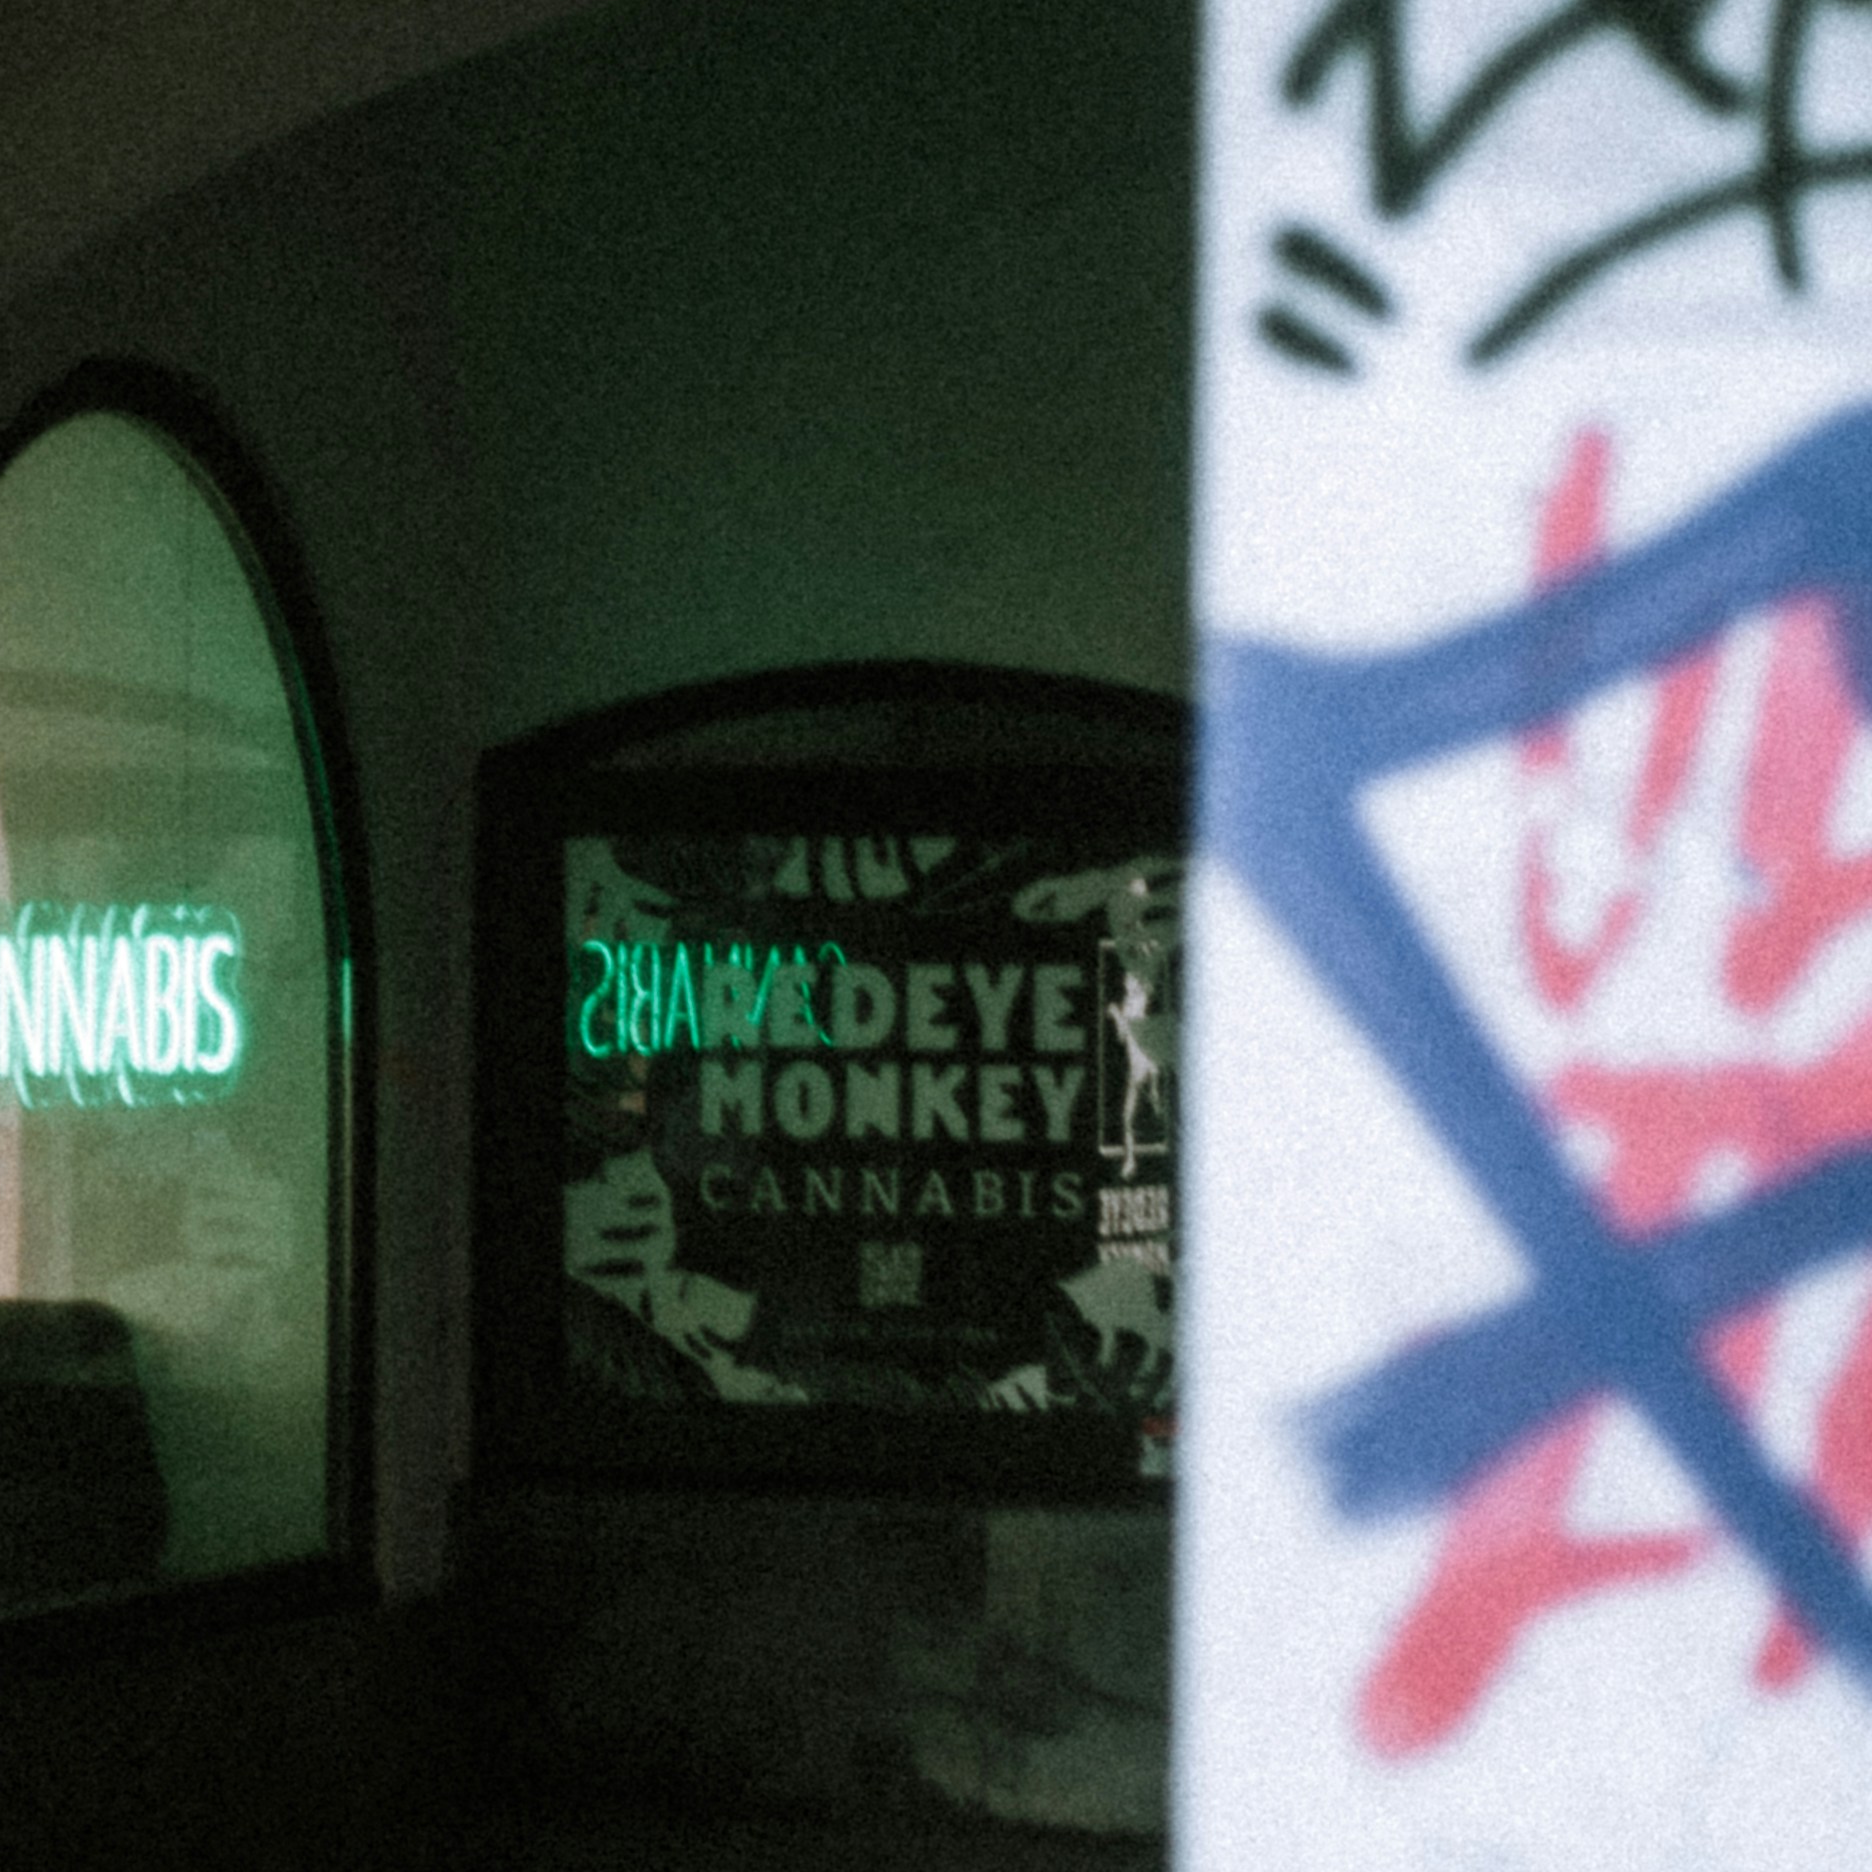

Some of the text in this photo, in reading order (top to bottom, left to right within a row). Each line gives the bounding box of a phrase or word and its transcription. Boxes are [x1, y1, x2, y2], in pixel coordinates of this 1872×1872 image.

[700, 962, 1088, 1052] REDEYE
[698, 1059, 1088, 1142] MONKEY
[699, 1161, 1087, 1220] CANNABIS
